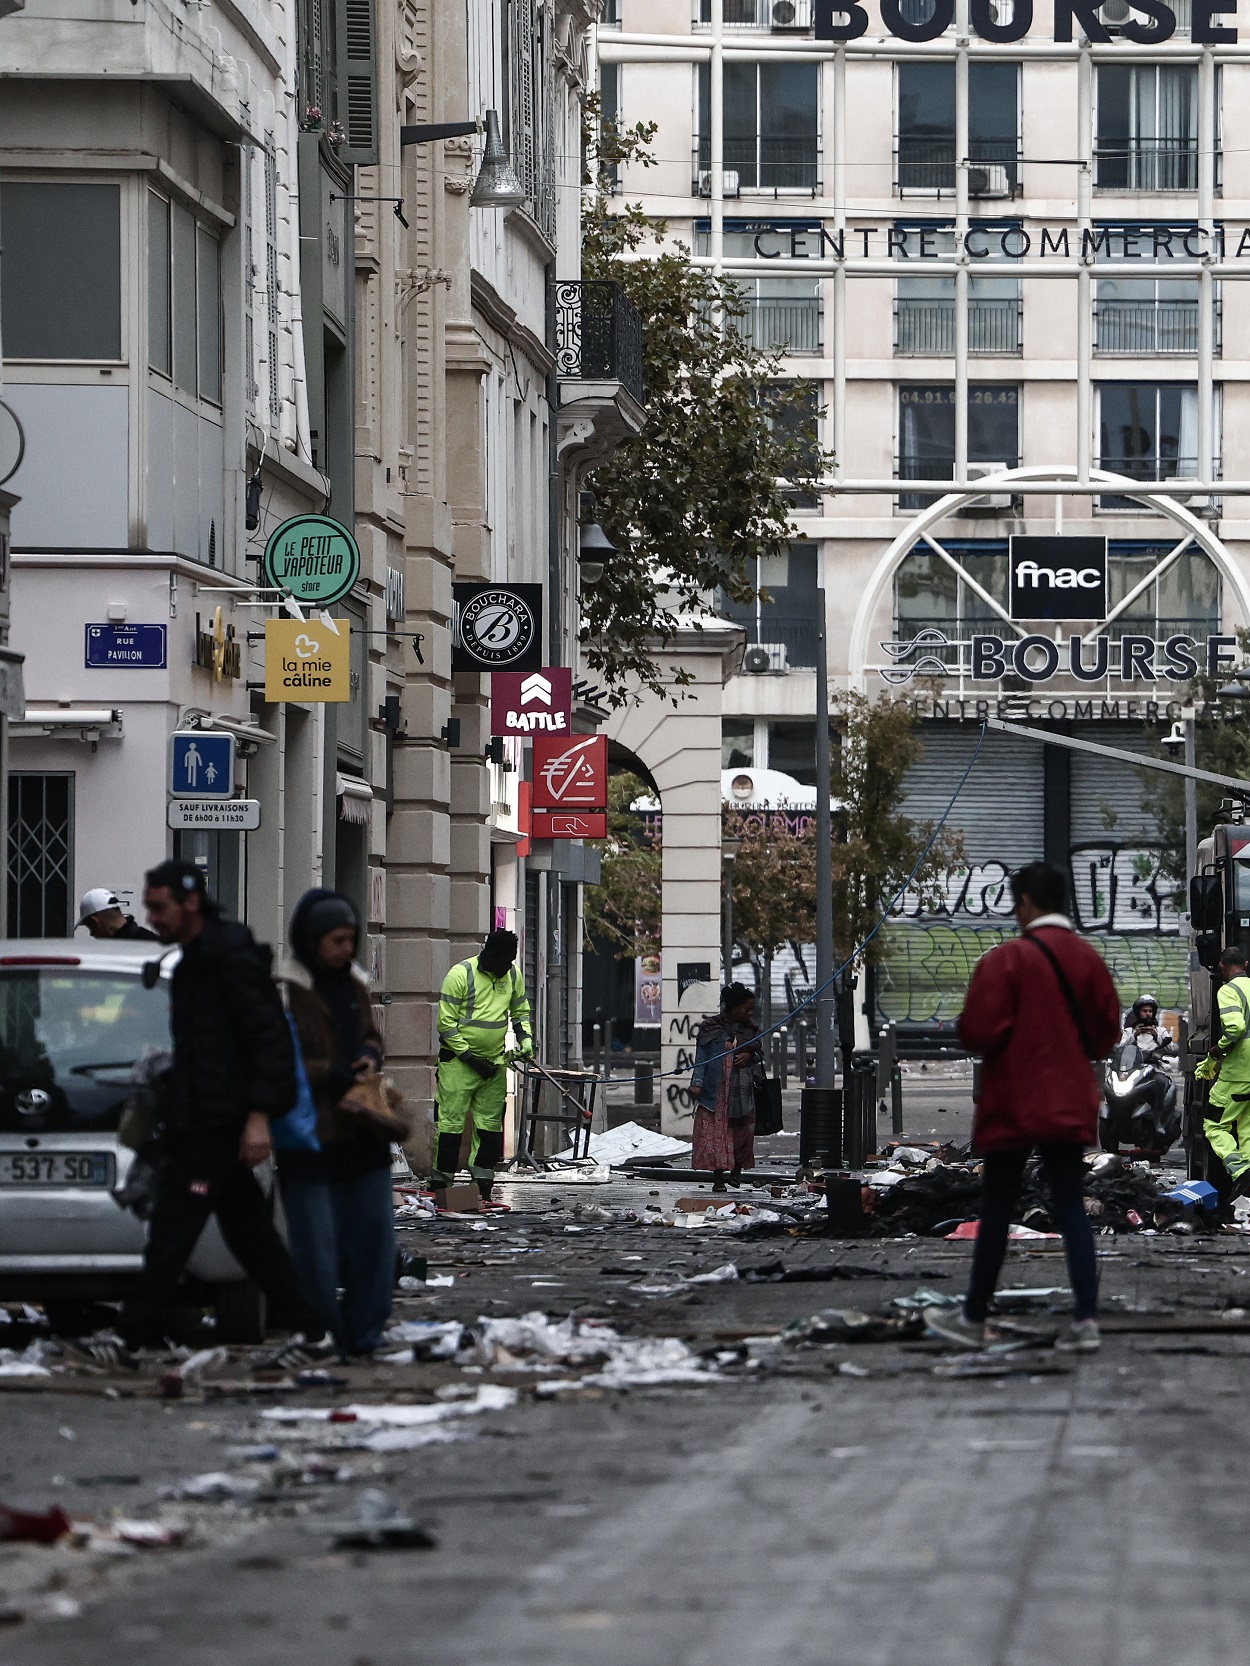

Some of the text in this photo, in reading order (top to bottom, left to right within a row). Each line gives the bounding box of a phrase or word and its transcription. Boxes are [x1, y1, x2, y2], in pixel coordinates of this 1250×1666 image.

[814, 0, 1238, 44] BOURSE
[754, 227, 938, 258] CENTRE
[285, 535, 333, 556] LE PETIT
[283, 555, 343, 577] VAPOTEUR
[1015, 561, 1101, 588] fnac
[301, 581, 321, 592] store
[465, 594, 529, 622] BOUCHARA
[107, 650, 142, 660] PAVILLON
[466, 634, 527, 659] DEPUIS 1899
[282, 657, 332, 672] la mie
[971, 633, 1239, 683] BOURSE
[283, 673, 332, 687] câline
[506, 711, 566, 732] BATTLE
[179, 803, 249, 812] SAUF LIVRAISONS
